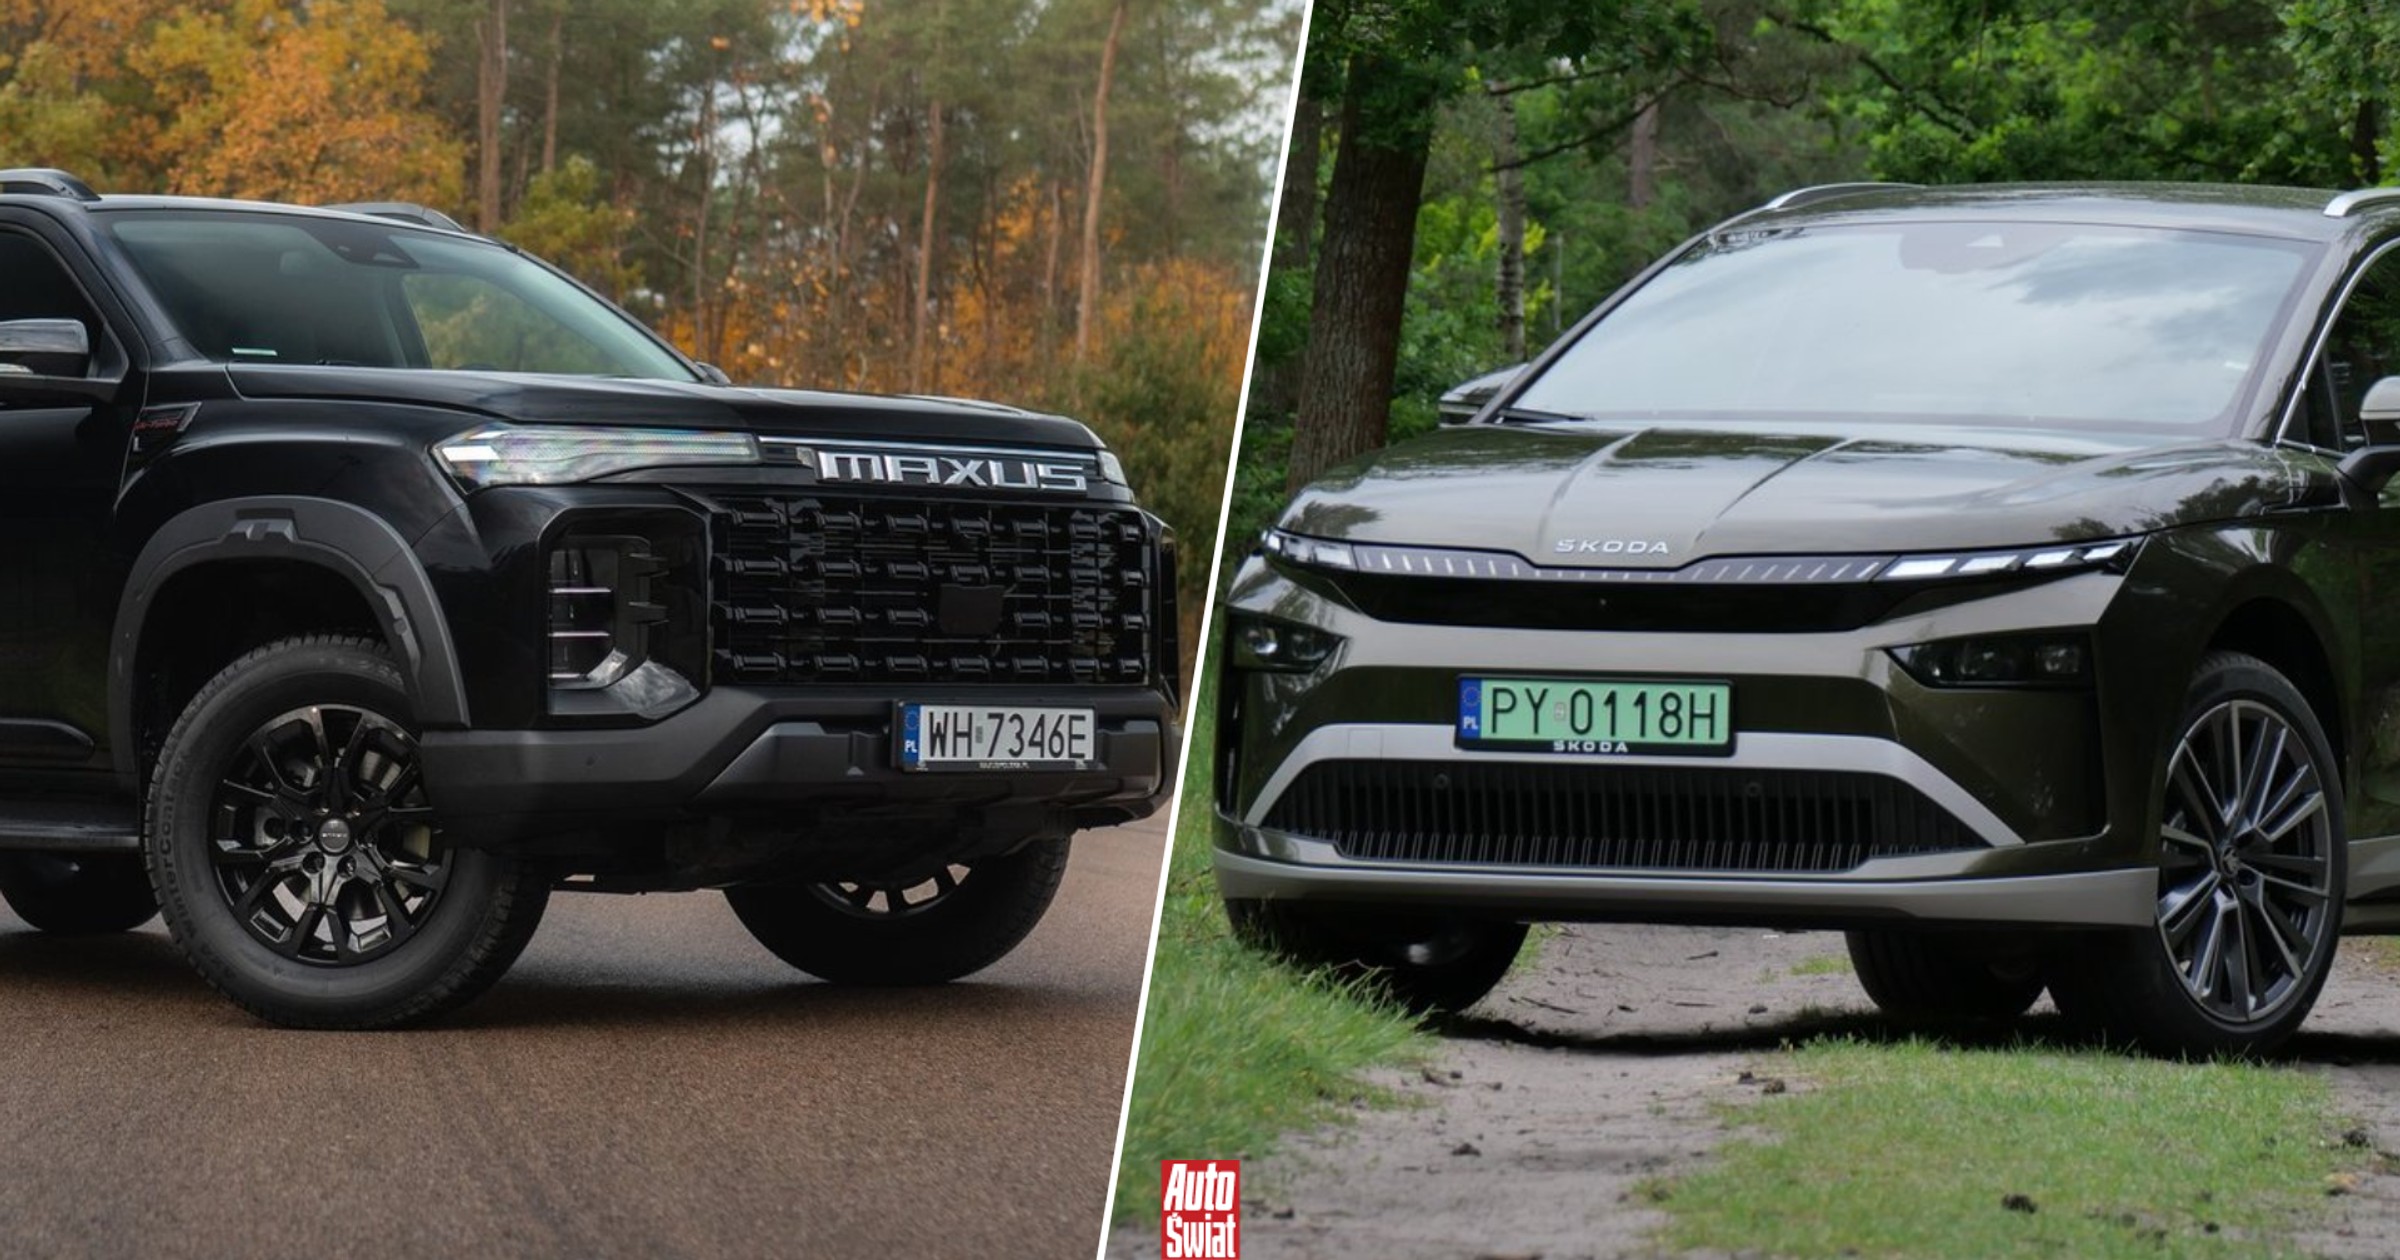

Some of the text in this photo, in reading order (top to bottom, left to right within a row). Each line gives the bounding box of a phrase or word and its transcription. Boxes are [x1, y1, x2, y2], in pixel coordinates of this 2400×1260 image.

[818, 451, 1087, 491] MAXUS
[1463, 716, 1478, 729] PL
[1491, 687, 1716, 740] PY 0118H
[904, 740, 917, 752] PL
[928, 711, 1086, 759] WH 7346E
